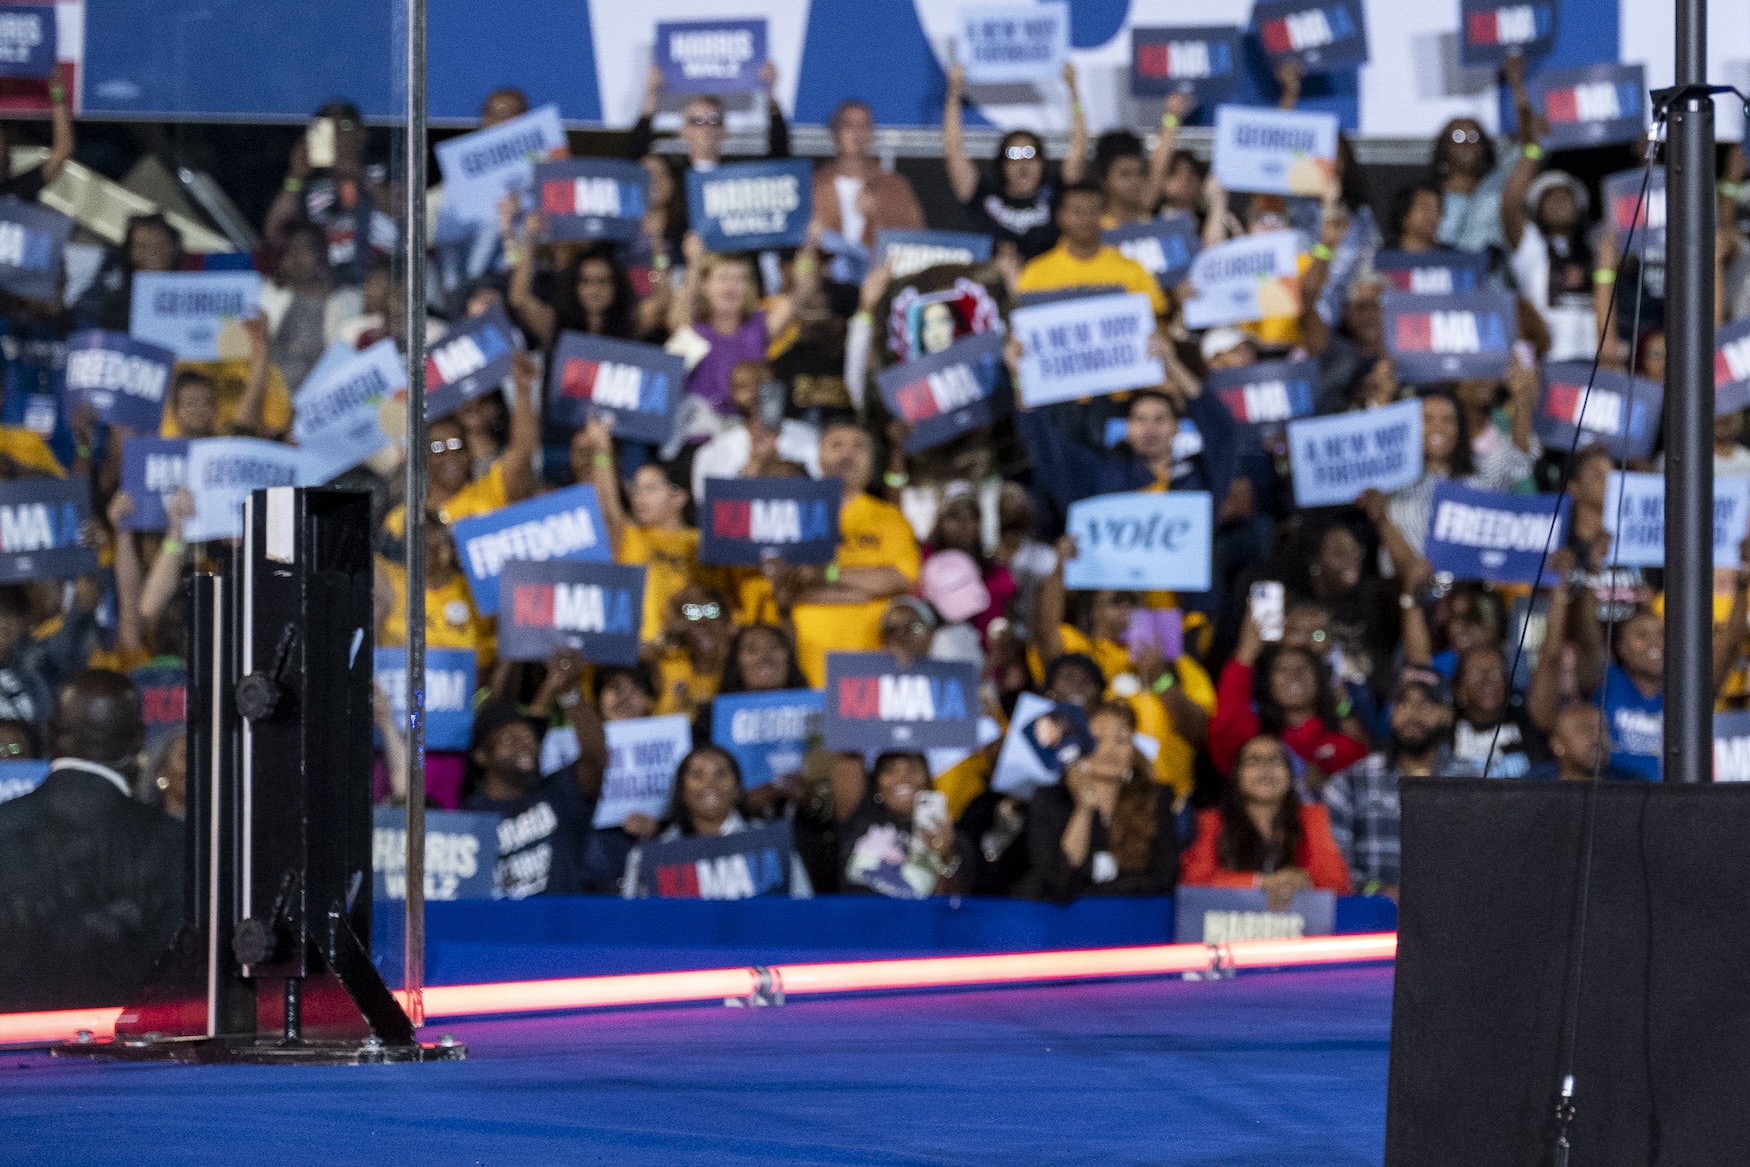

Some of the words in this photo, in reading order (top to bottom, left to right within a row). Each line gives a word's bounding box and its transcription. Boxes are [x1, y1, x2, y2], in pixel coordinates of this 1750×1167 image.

[1086, 509, 1191, 556] vote
[1434, 500, 1563, 555] FREEDOM
[372, 828, 480, 879] HARIS
